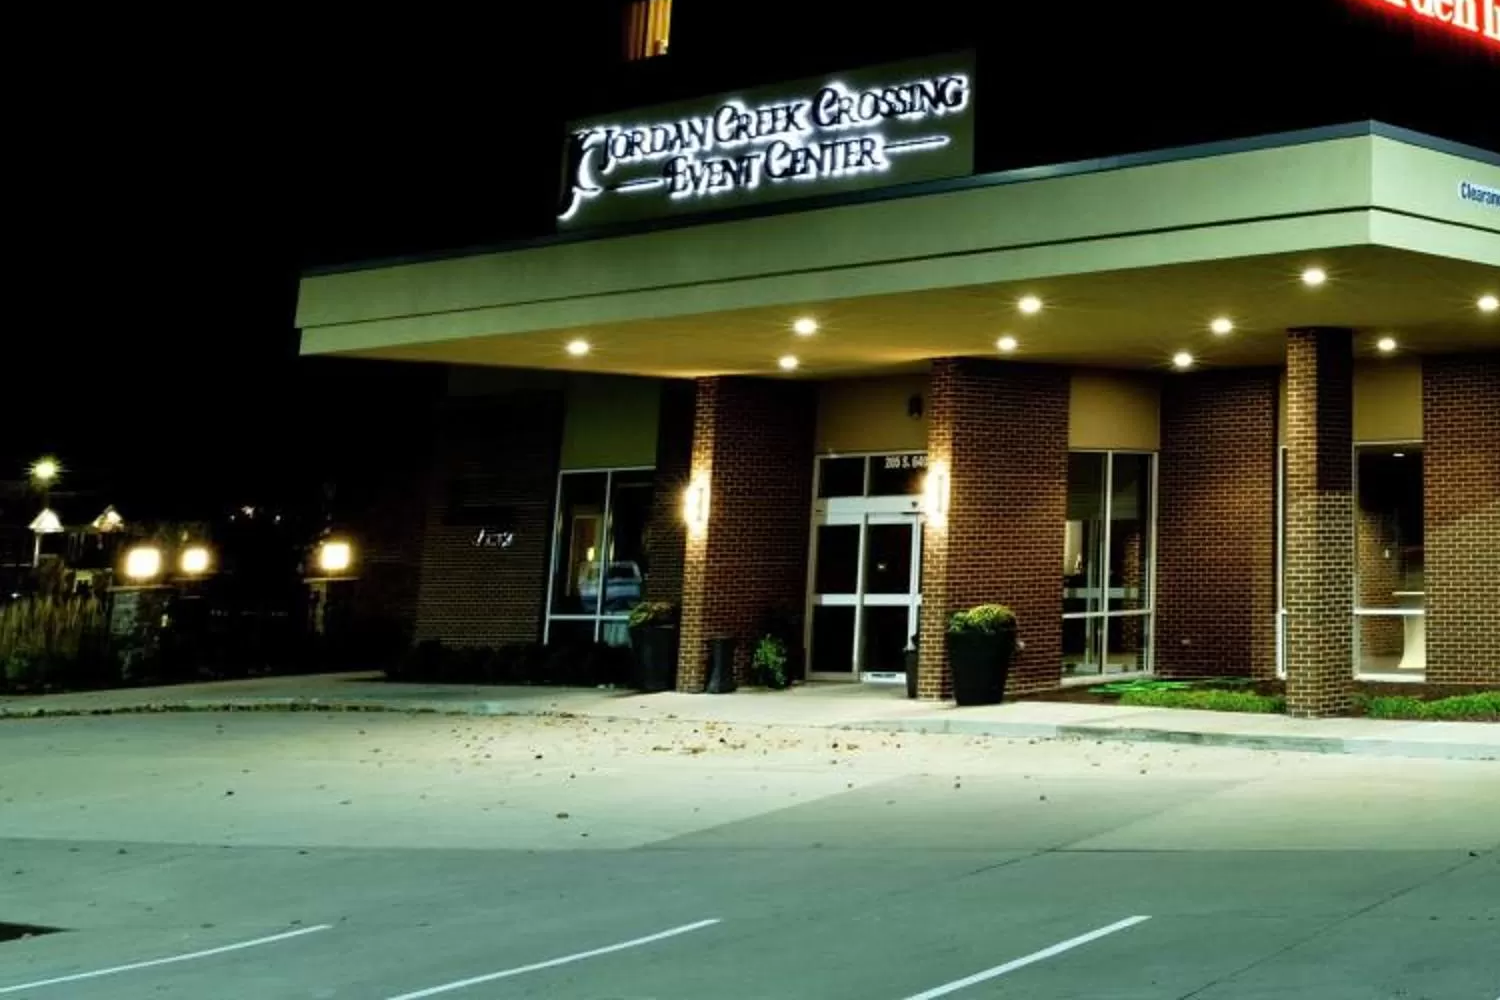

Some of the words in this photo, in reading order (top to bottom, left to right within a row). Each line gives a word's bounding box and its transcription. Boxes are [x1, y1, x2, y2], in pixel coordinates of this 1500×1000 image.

[812, 77, 964, 127] CROSSING
[662, 152, 762, 194] EVENT
[764, 138, 880, 178] CENTER
